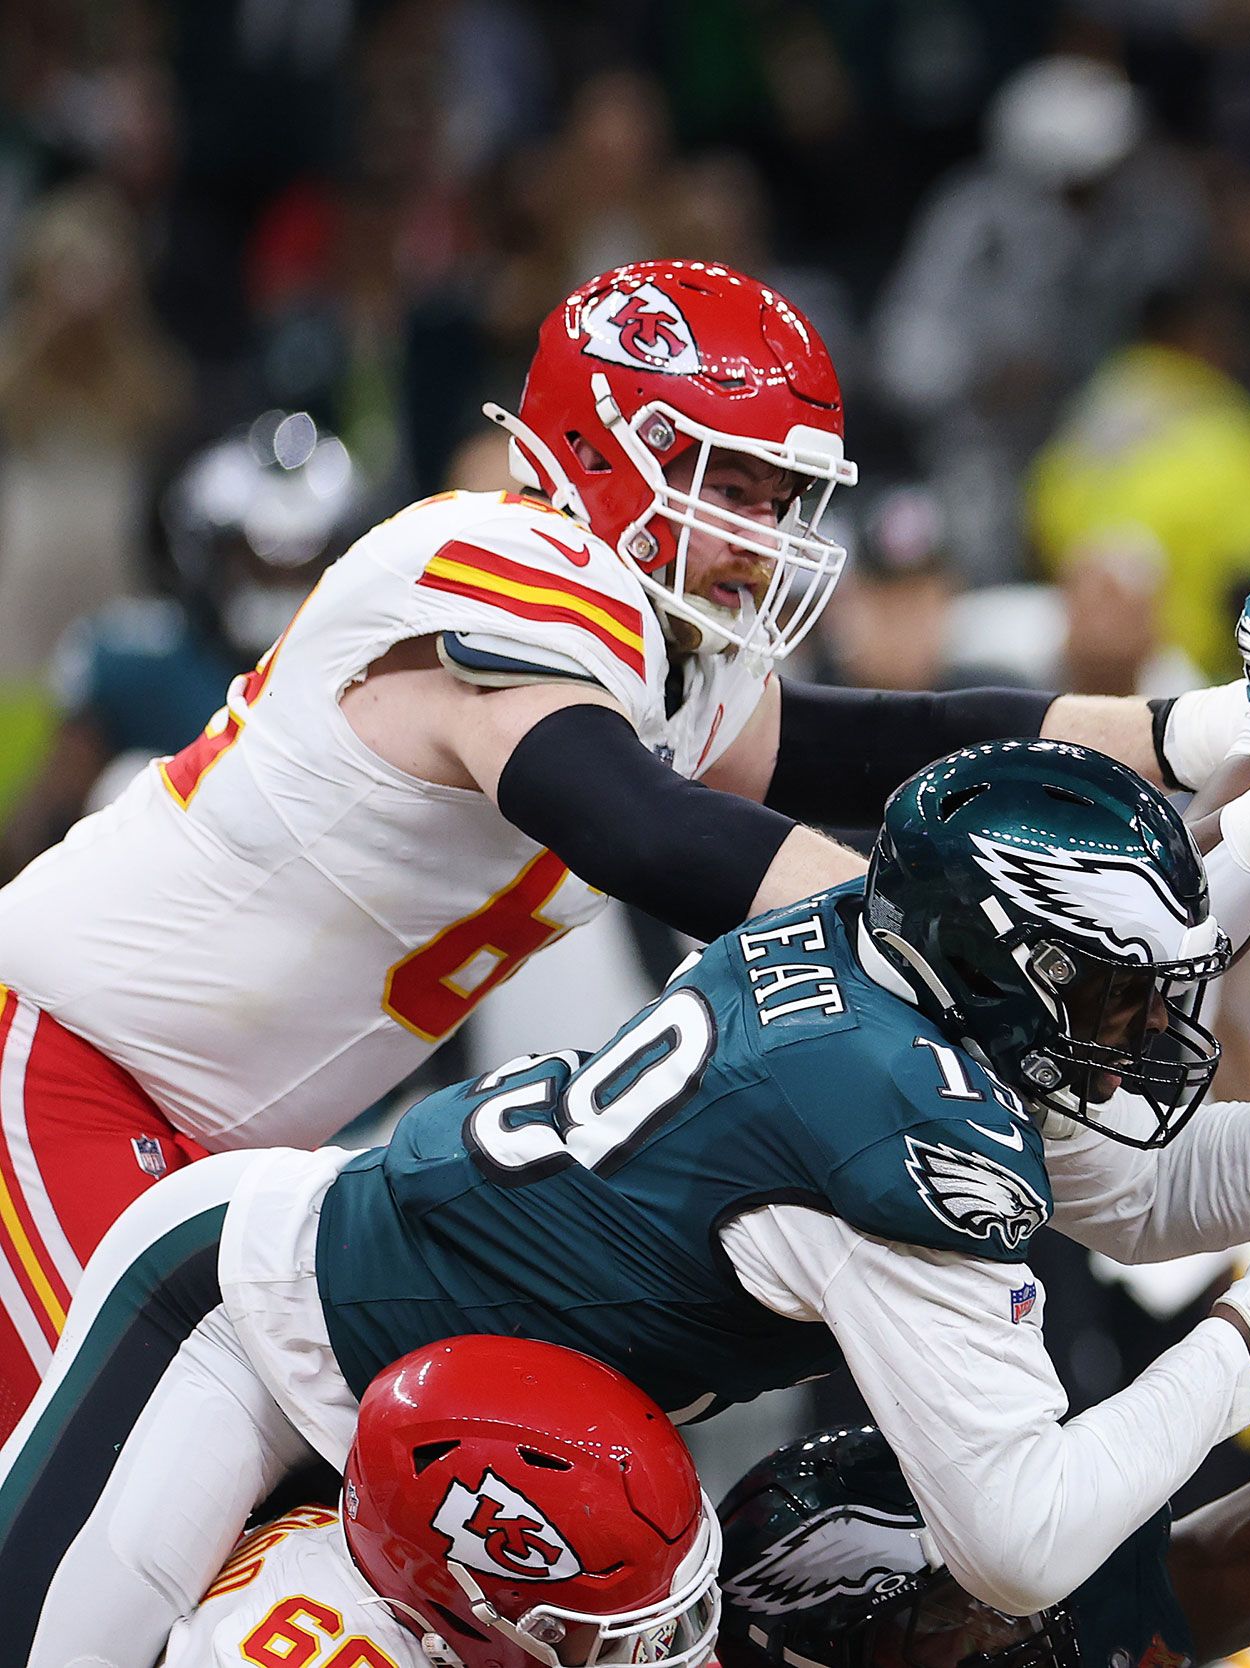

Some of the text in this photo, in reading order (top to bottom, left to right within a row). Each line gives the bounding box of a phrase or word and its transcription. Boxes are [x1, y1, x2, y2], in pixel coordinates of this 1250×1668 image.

[606, 296, 688, 367] KC
[381, 847, 572, 1045] 6
[740, 893, 845, 1026] EAT
[461, 1493, 564, 1578] KC
[871, 1579, 918, 1605] OAKLEY
